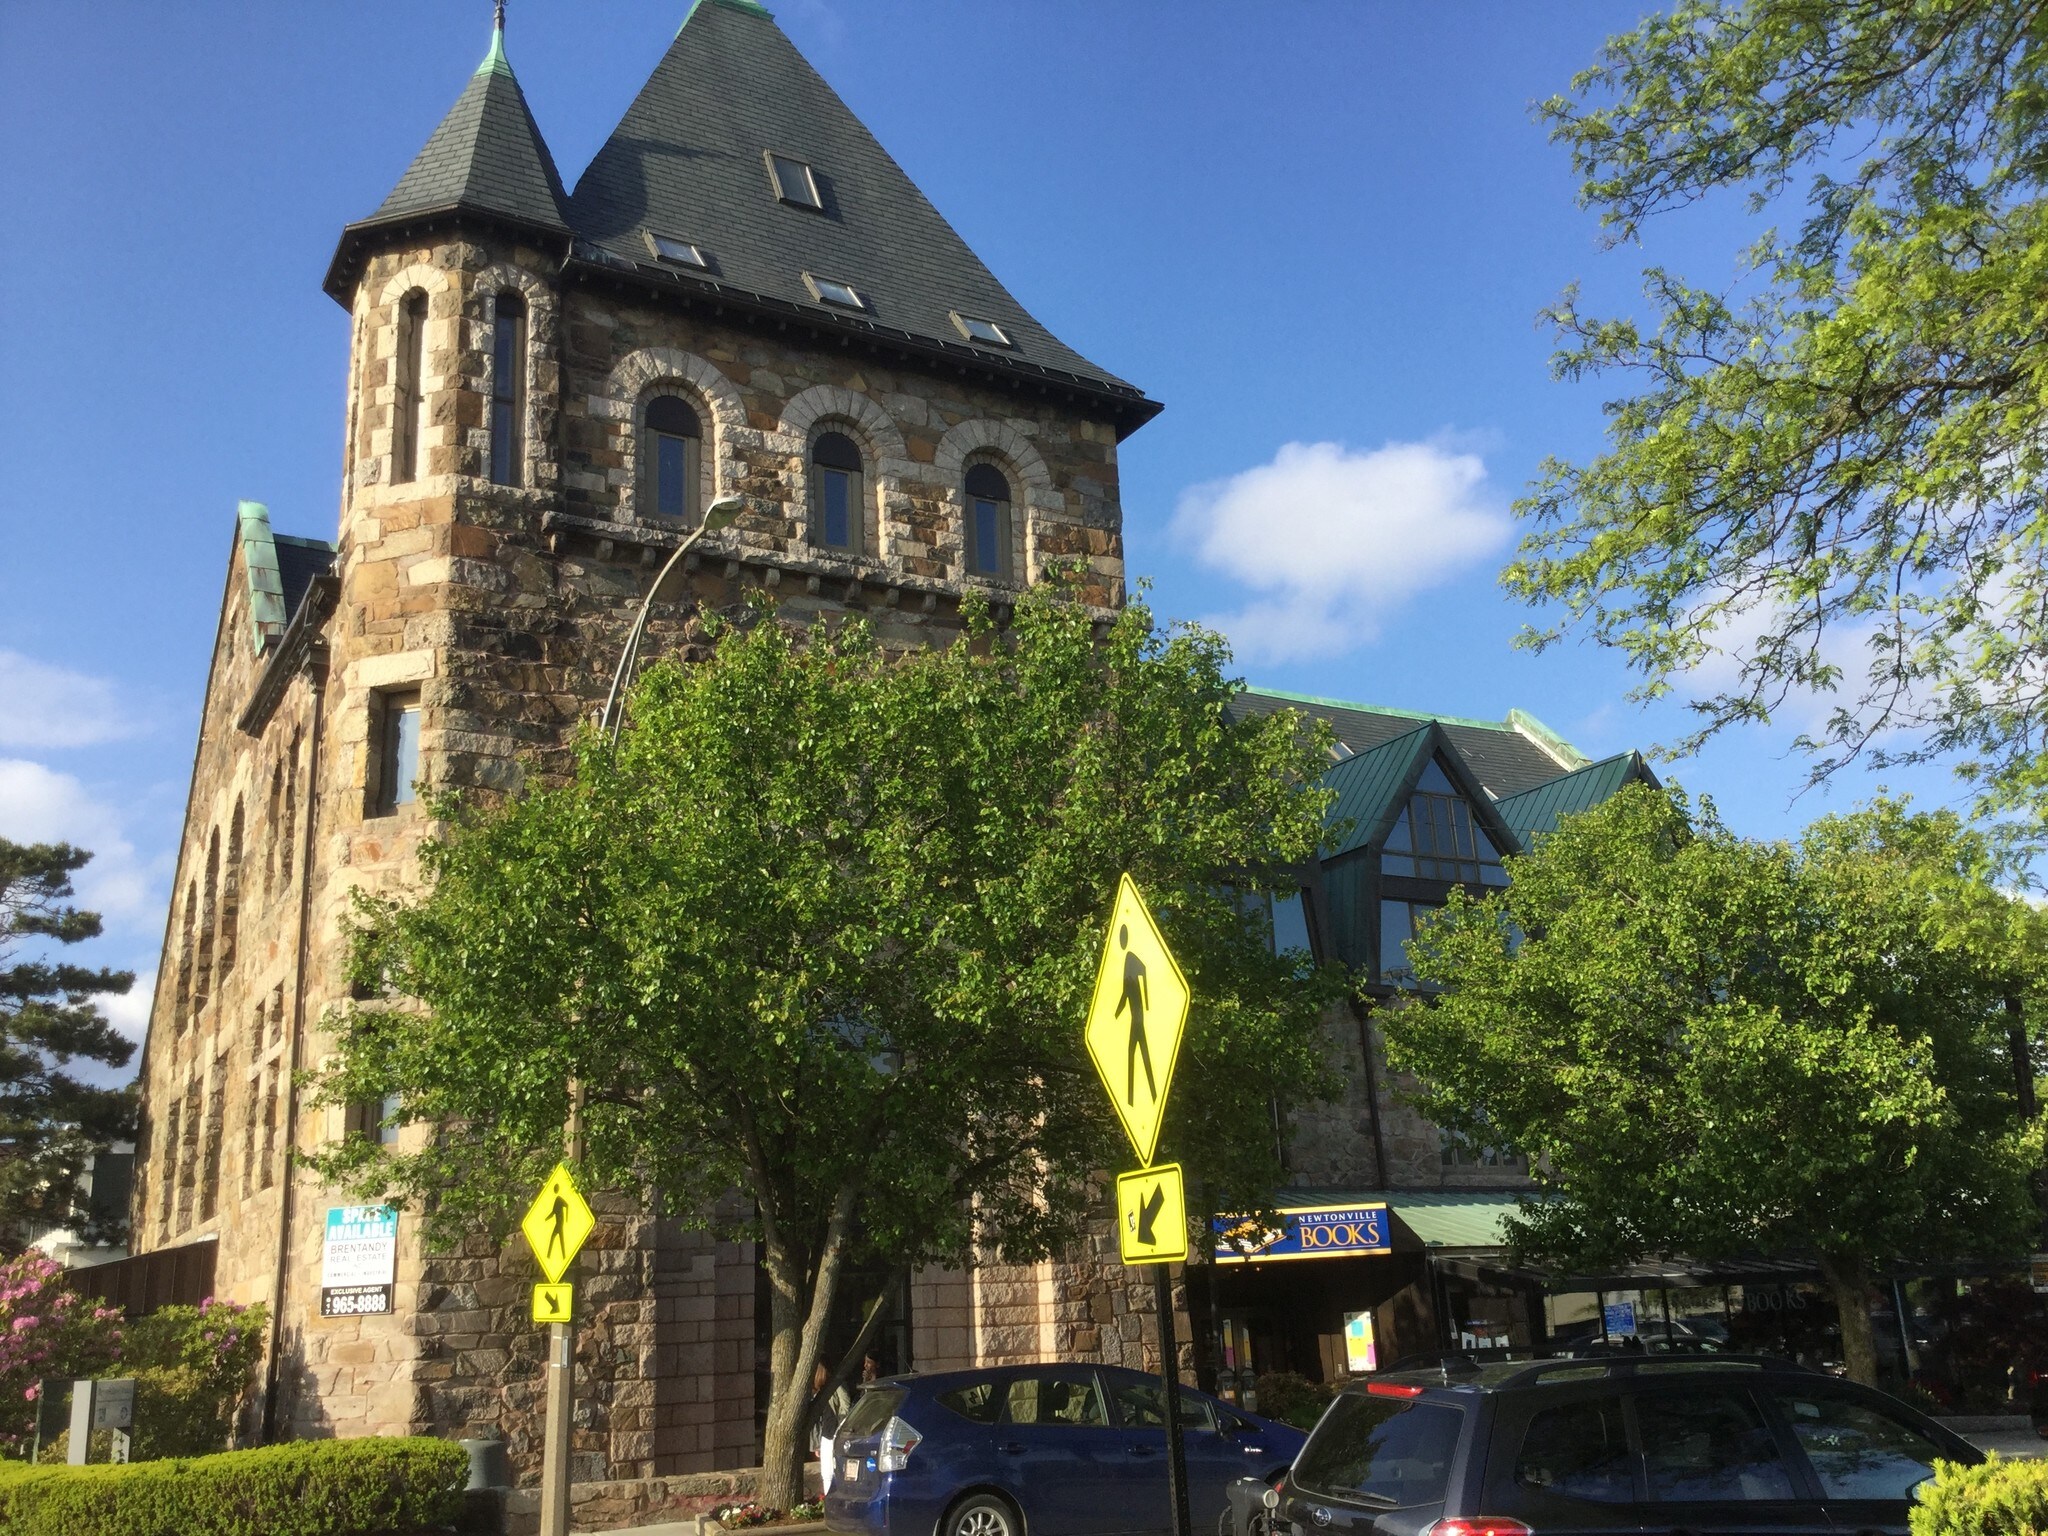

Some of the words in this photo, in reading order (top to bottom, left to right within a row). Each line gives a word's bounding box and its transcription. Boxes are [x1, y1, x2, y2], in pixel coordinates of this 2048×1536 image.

[1298, 1211, 1377, 1223] NEWTONVILLE
[327, 1221, 394, 1241] AVAILABLE
[1299, 1222, 1380, 1248] BOOKS
[330, 1242, 388, 1254] BRENTANDY
[330, 1255, 351, 1263] REAL
[356, 1253, 386, 1262] ESTATE
[330, 1287, 362, 1295] EXCLUSIVE
[362, 1285, 383, 1293] AGENT
[332, 1293, 387, 1314] 965-8888
[1745, 1290, 1806, 1312] BOOKS
